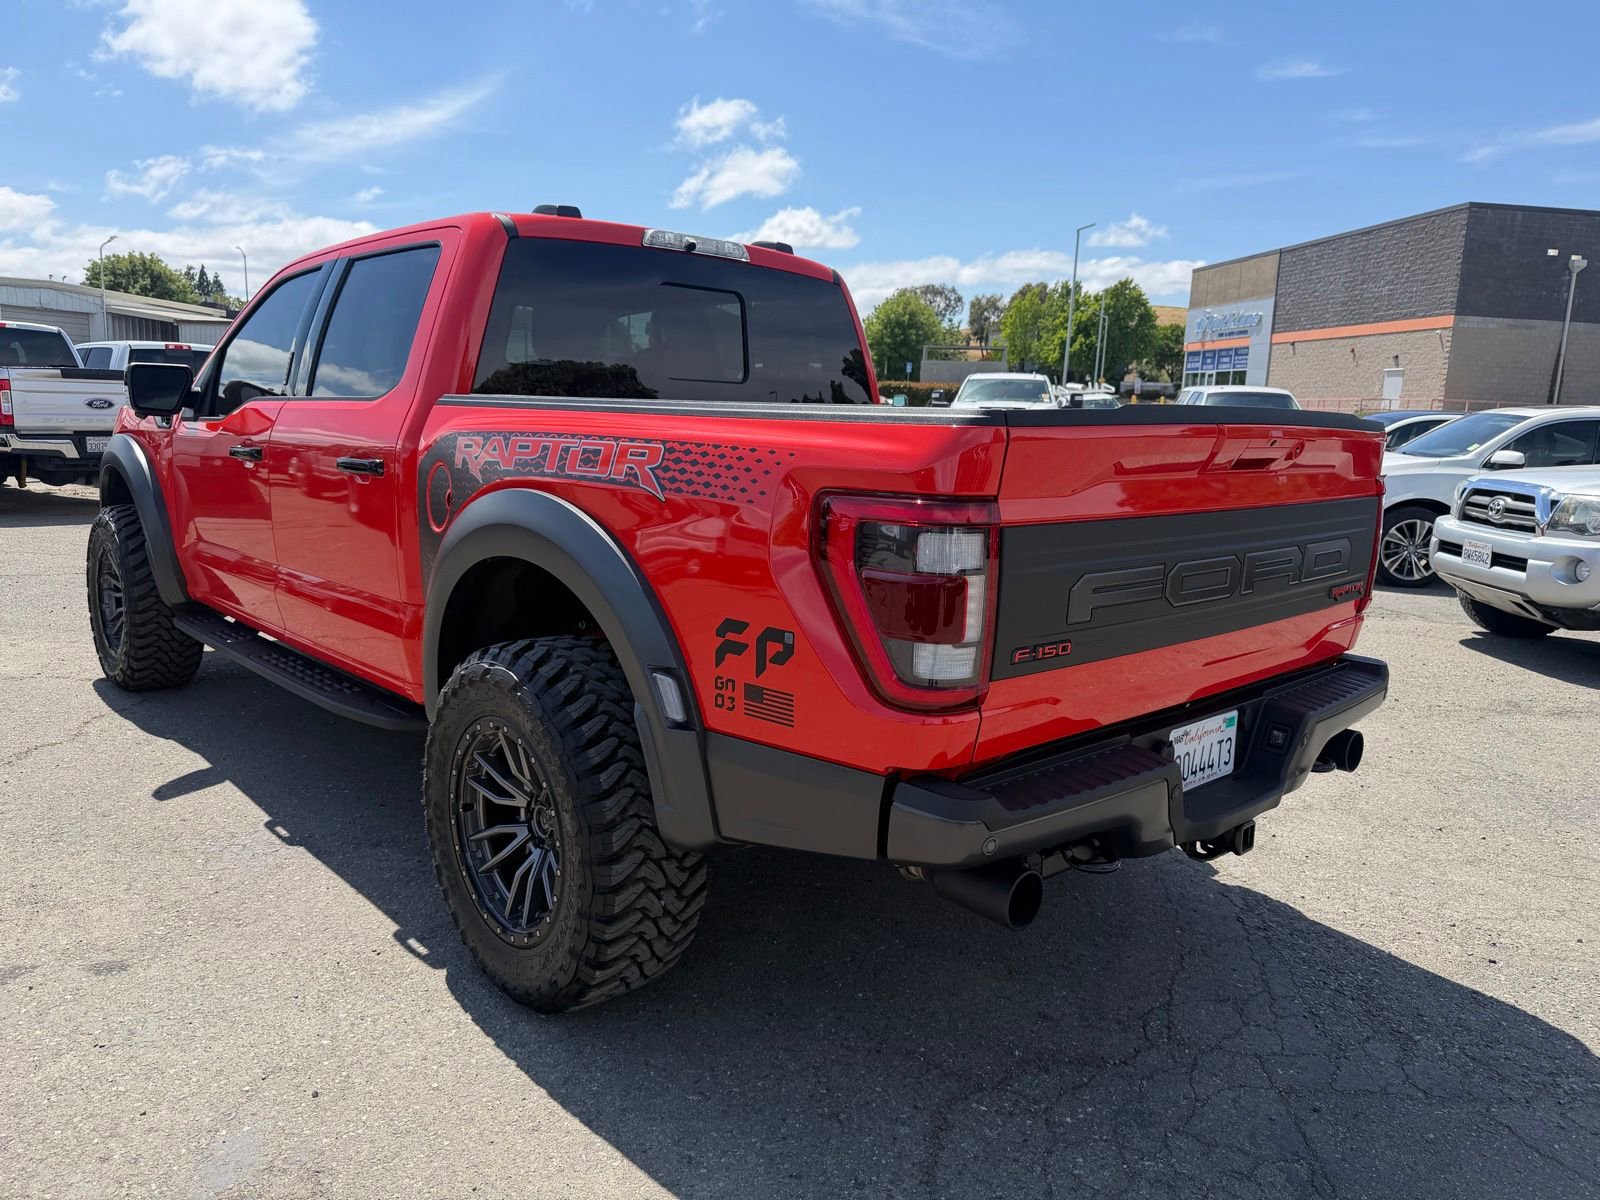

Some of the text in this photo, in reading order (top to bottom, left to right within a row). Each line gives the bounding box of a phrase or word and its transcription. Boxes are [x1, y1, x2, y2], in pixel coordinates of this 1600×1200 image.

[454, 436, 666, 503] RAPTOR
[1066, 537, 1352, 625] FORD
[1014, 642, 1071, 664] F-150
[1184, 725, 1225, 746] California
